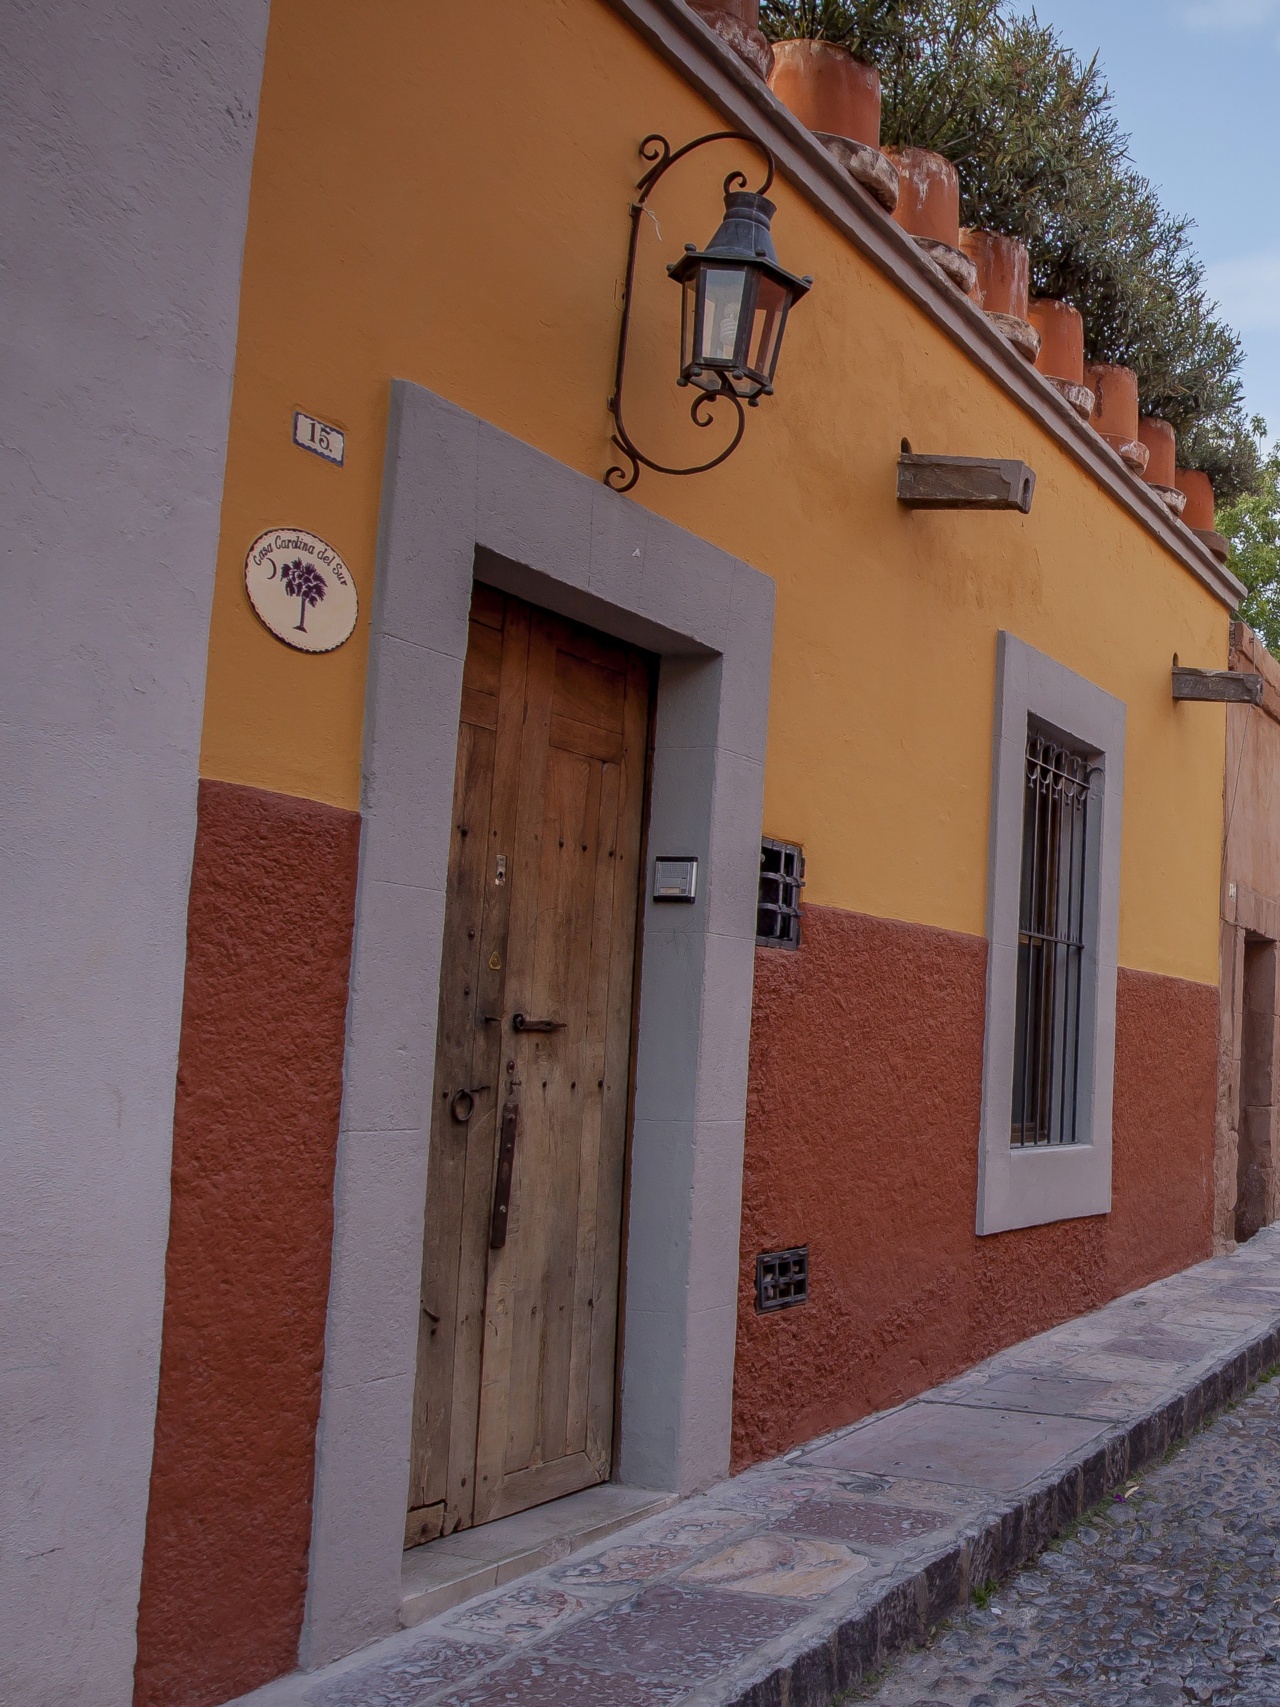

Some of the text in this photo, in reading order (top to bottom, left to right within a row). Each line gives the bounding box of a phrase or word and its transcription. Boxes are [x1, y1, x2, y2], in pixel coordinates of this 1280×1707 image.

[252, 534, 348, 587] Casa Carolina del Sur
